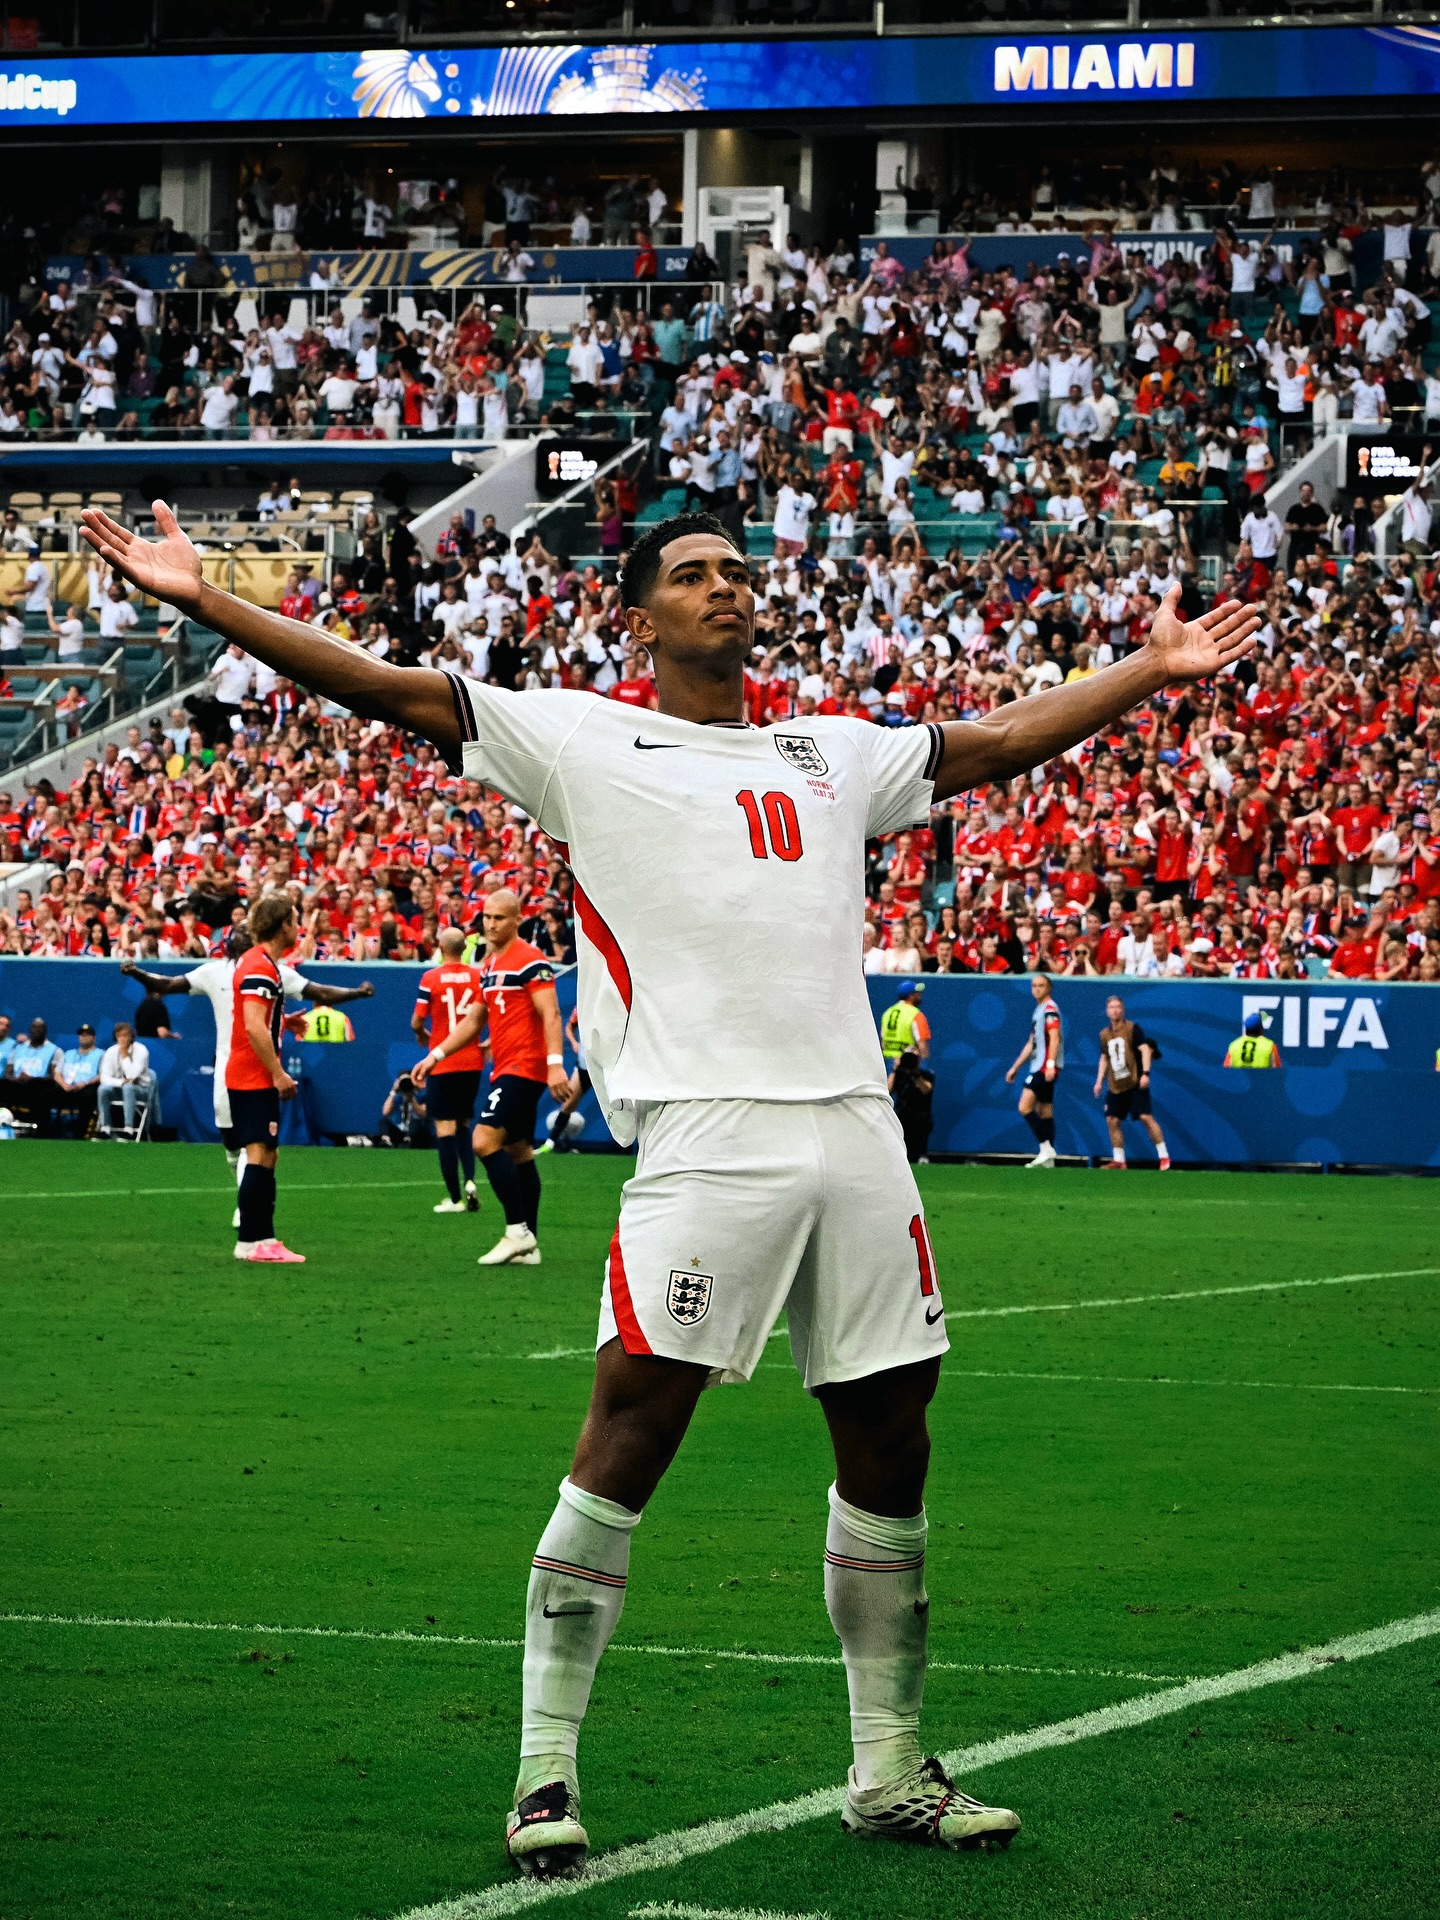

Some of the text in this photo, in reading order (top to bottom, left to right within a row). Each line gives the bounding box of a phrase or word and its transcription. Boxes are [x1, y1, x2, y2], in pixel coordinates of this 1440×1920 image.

[994, 43, 1195, 91] MIAMI
[806, 779, 834, 791] NORWAY
[735, 789, 804, 862] 10
[440, 986, 473, 1035] 14
[494, 989, 506, 1015] 4
[1242, 995, 1389, 1050] FIFA
[487, 1087, 503, 1111] 4
